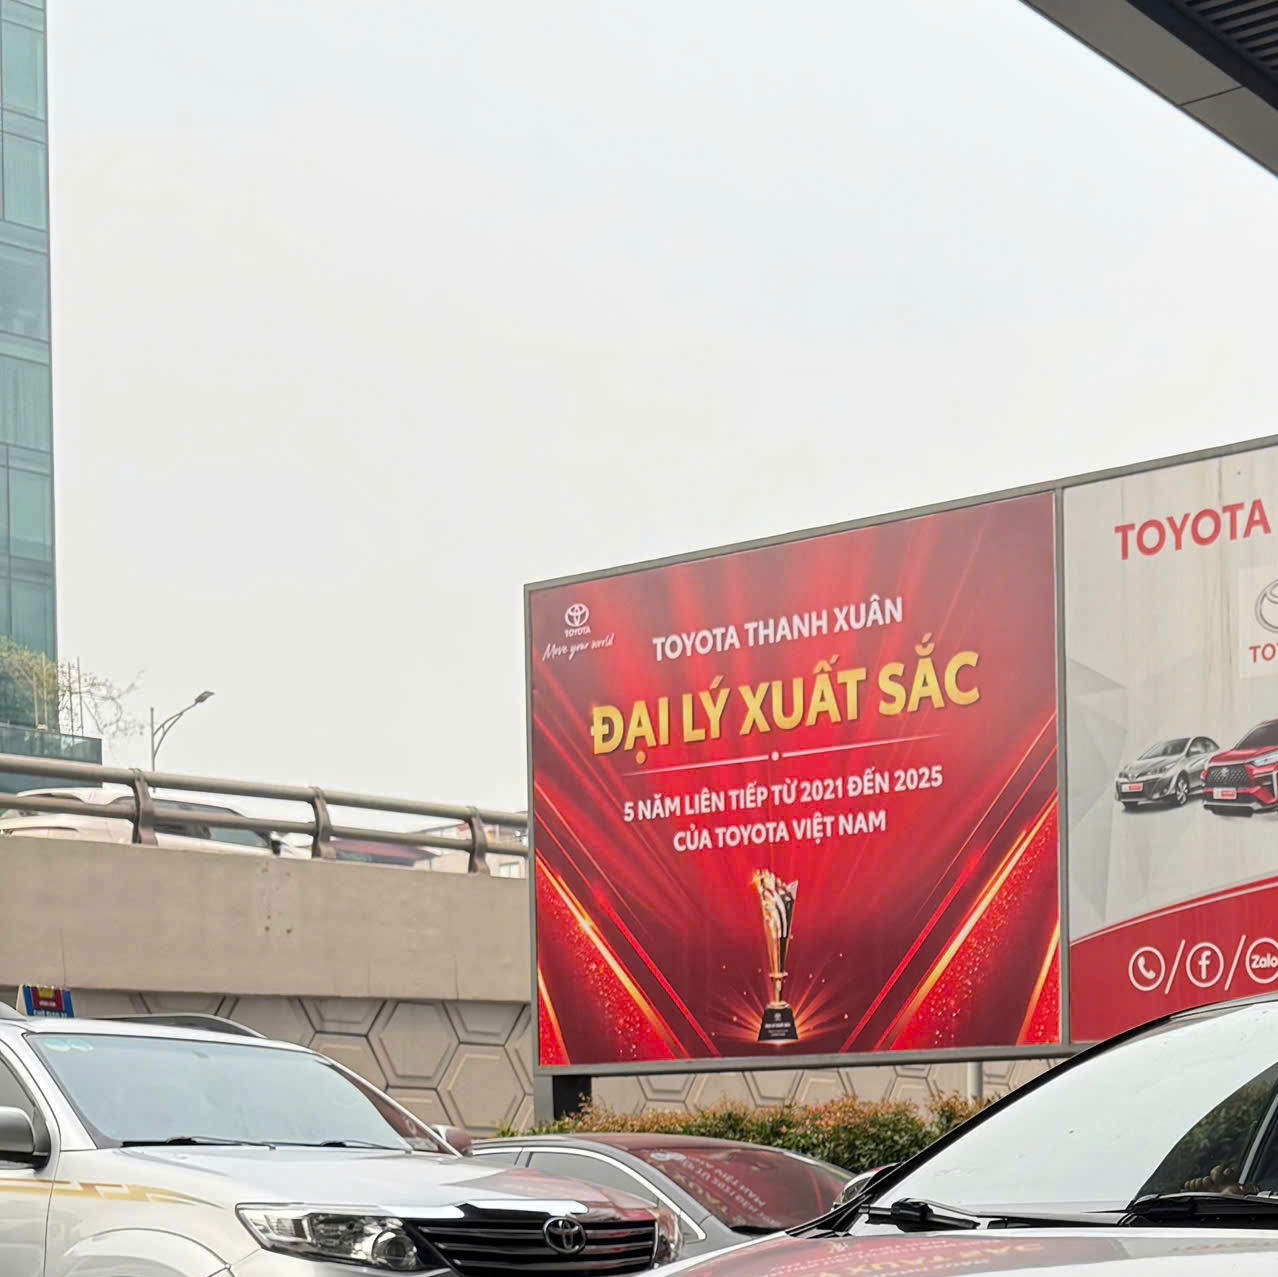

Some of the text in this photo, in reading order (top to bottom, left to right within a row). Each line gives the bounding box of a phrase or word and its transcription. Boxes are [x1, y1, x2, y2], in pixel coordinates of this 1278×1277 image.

[1114, 499, 1271, 561] TOYOTA
[564, 625, 591, 638] TOYOTA
[652, 593, 904, 661] TOYOTA THANH XUÂN
[590, 632, 981, 765] ĐẠI LÝ XUẤT SẮC
[622, 765, 943, 823] 5 NĂM LIÊN TIẾP TỪ 2021 ĐẾN 2025
[672, 810, 886, 852] CỦA TOYOTA VIỆT NAM
